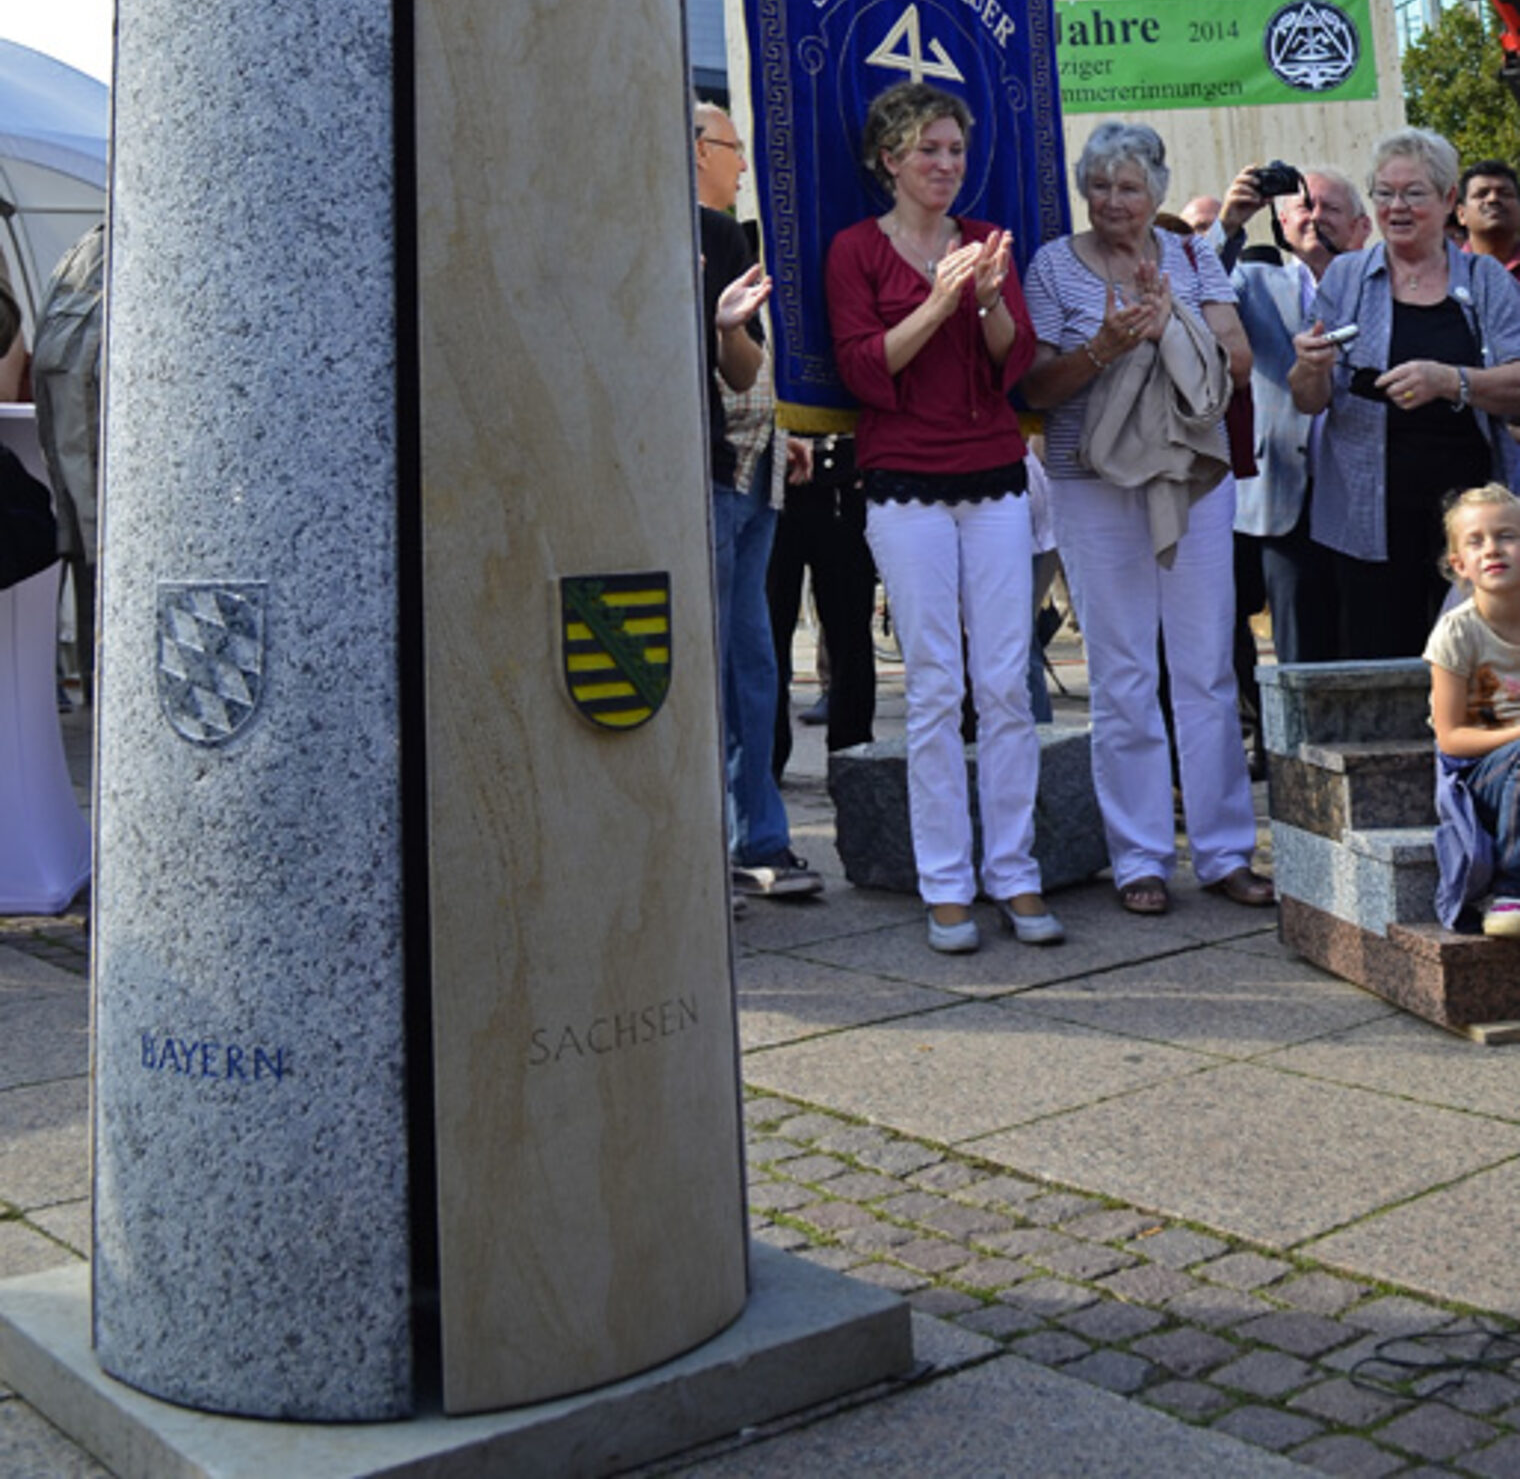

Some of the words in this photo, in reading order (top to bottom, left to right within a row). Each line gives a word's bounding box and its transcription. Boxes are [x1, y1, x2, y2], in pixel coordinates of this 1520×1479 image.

[1188, 20, 1240, 44] 2014
[528, 990, 699, 1066] SACHSEN
[141, 1031, 284, 1082] BAYERN
